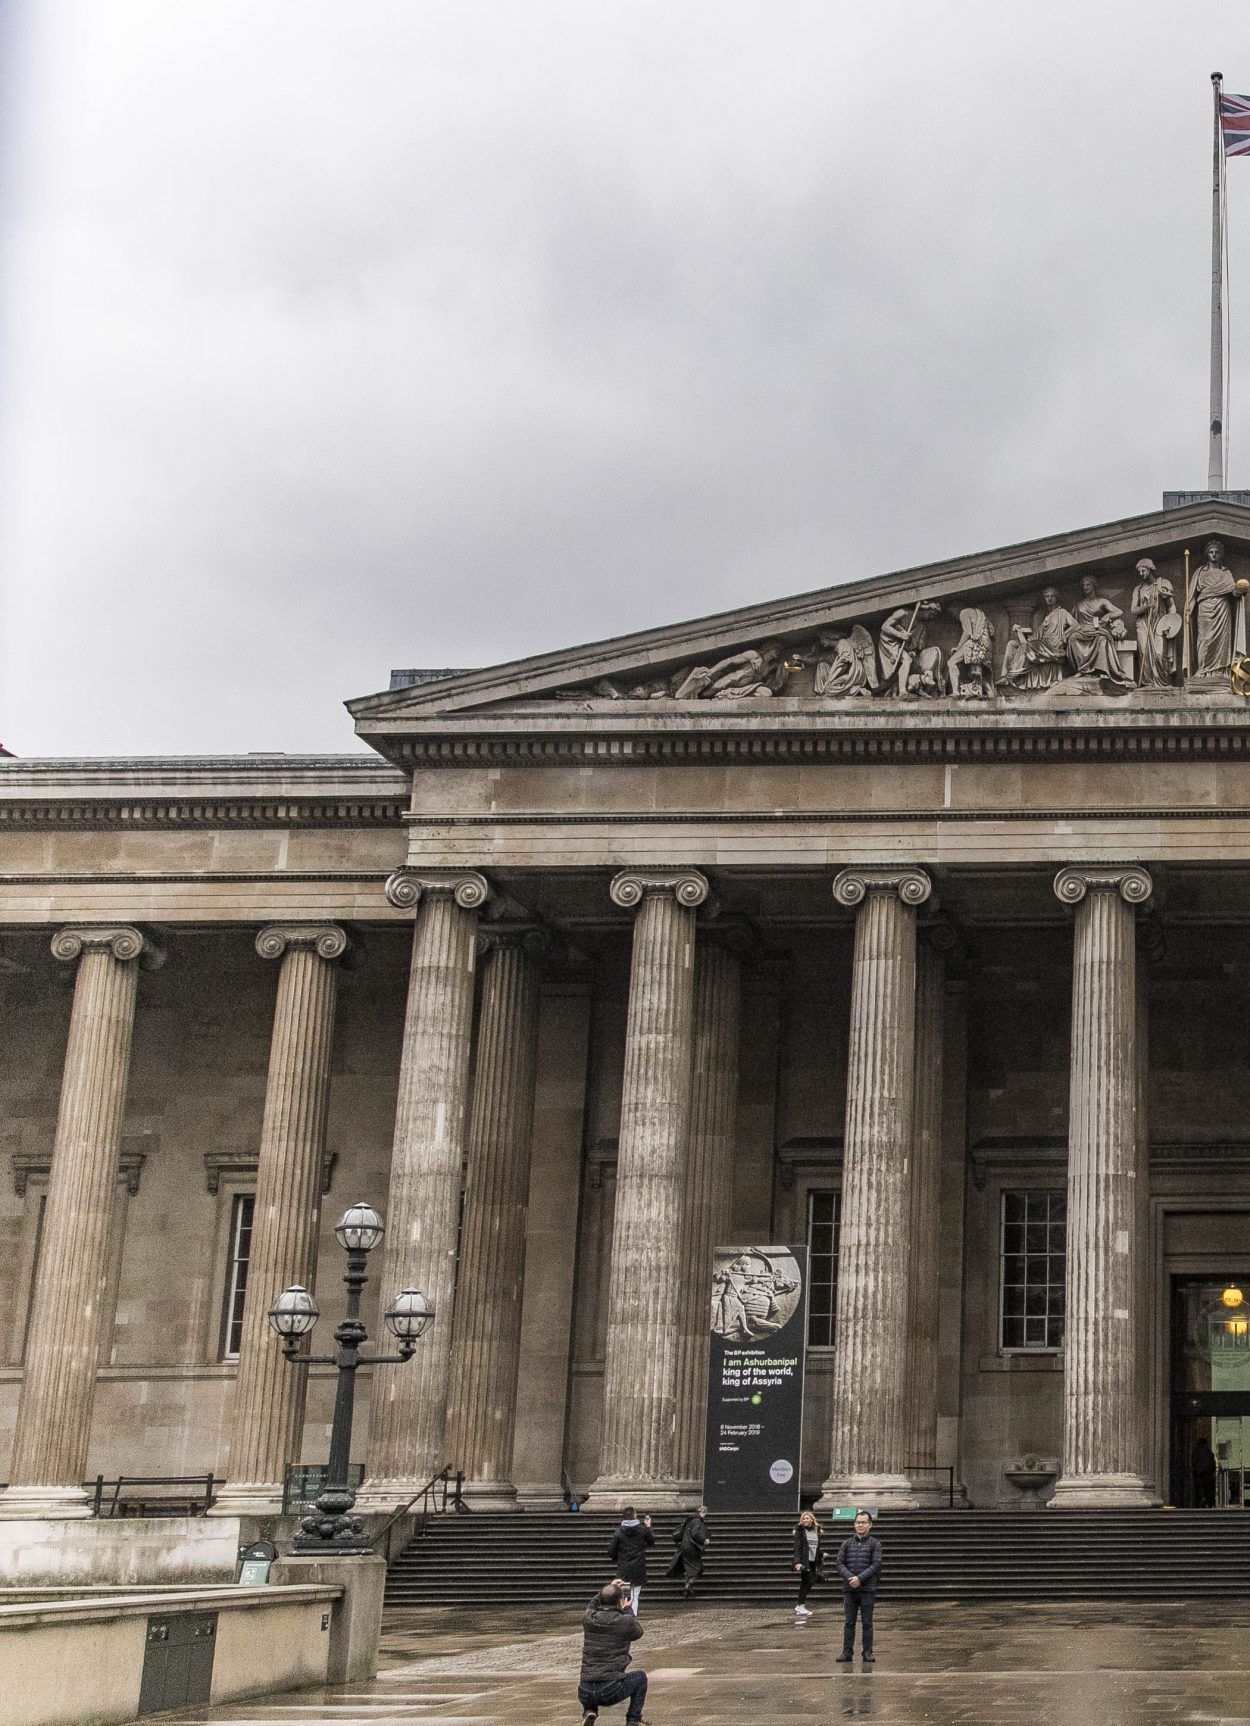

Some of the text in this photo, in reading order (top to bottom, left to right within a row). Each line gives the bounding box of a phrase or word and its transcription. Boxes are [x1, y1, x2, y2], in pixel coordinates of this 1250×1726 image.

[744, 1358, 798, 1367] Ashurbanipal
[722, 1366, 794, 1377] king of the world,
[722, 1377, 782, 1386] king of Assyria
